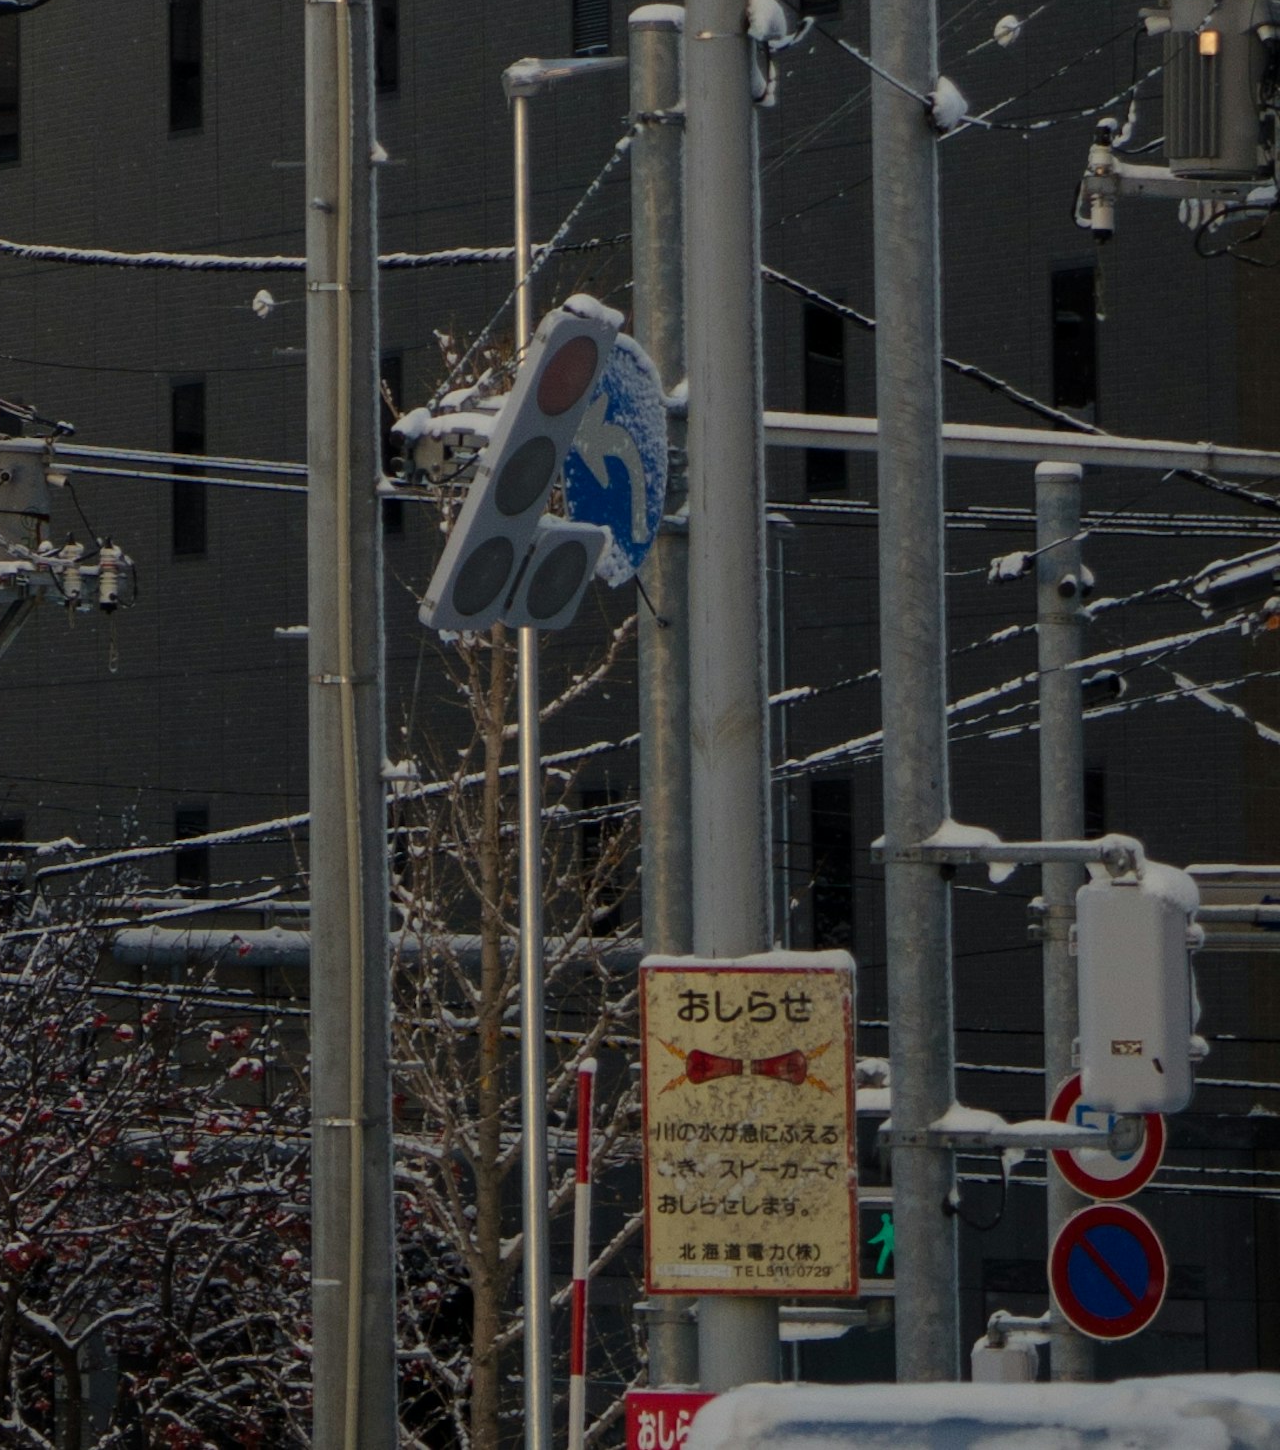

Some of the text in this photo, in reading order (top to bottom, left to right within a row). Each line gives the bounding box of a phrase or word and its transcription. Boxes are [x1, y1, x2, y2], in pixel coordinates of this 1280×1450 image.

[677, 989, 813, 1024] おしらせ
[654, 1122, 840, 1146] 川の水が急にふえる
[657, 1194, 811, 1217] おしらせします。
